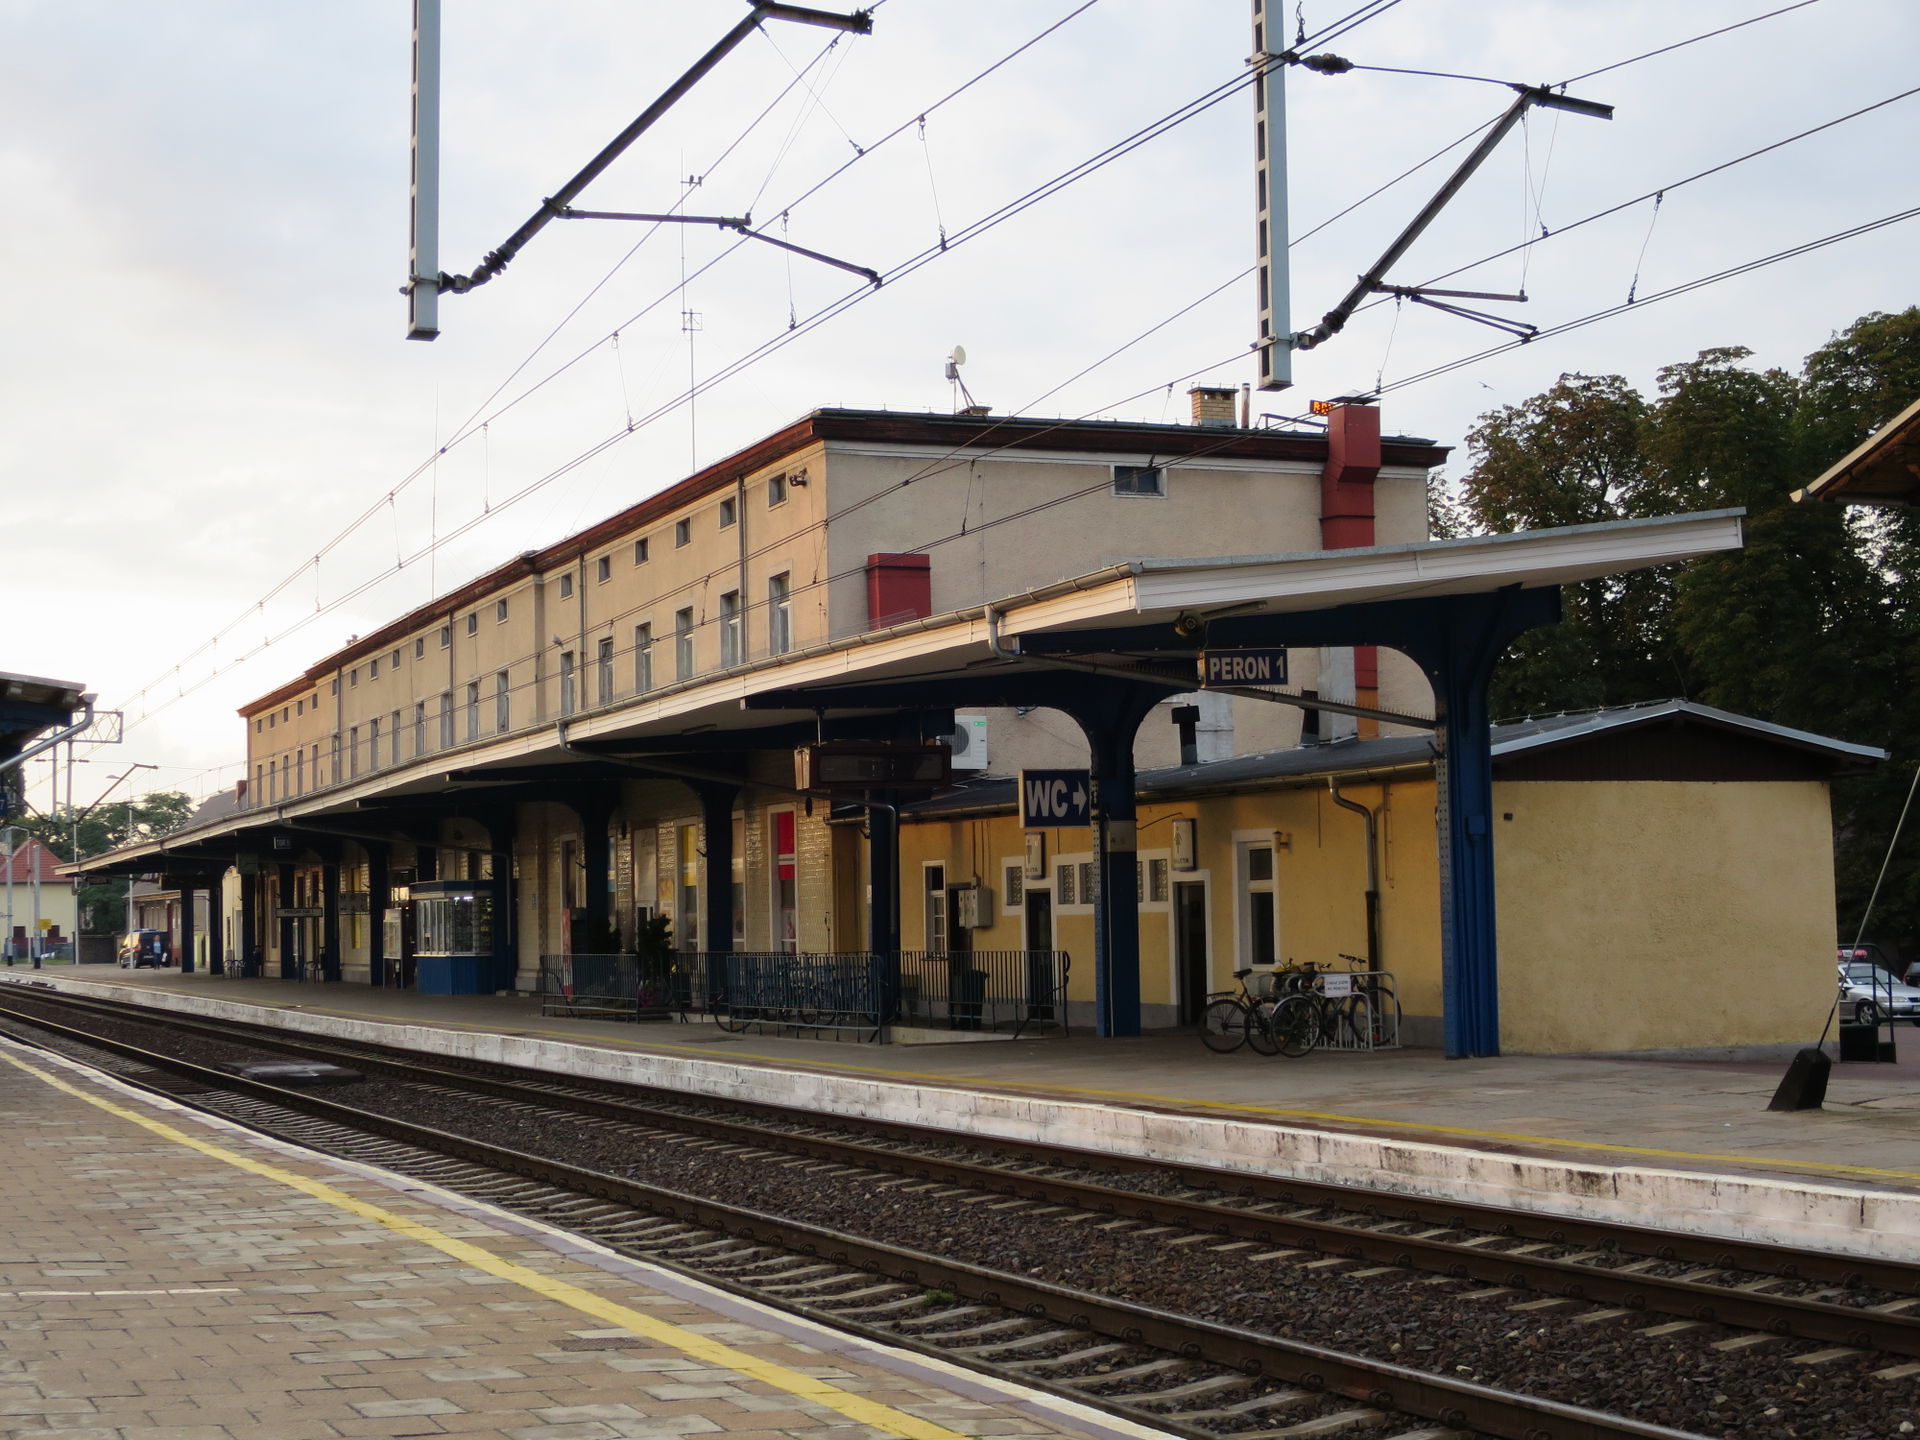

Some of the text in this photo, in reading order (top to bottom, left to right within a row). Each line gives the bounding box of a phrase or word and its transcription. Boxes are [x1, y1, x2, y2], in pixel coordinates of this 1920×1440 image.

[1209, 655, 1284, 680] PERON 1
[1026, 779, 1069, 818] WC
